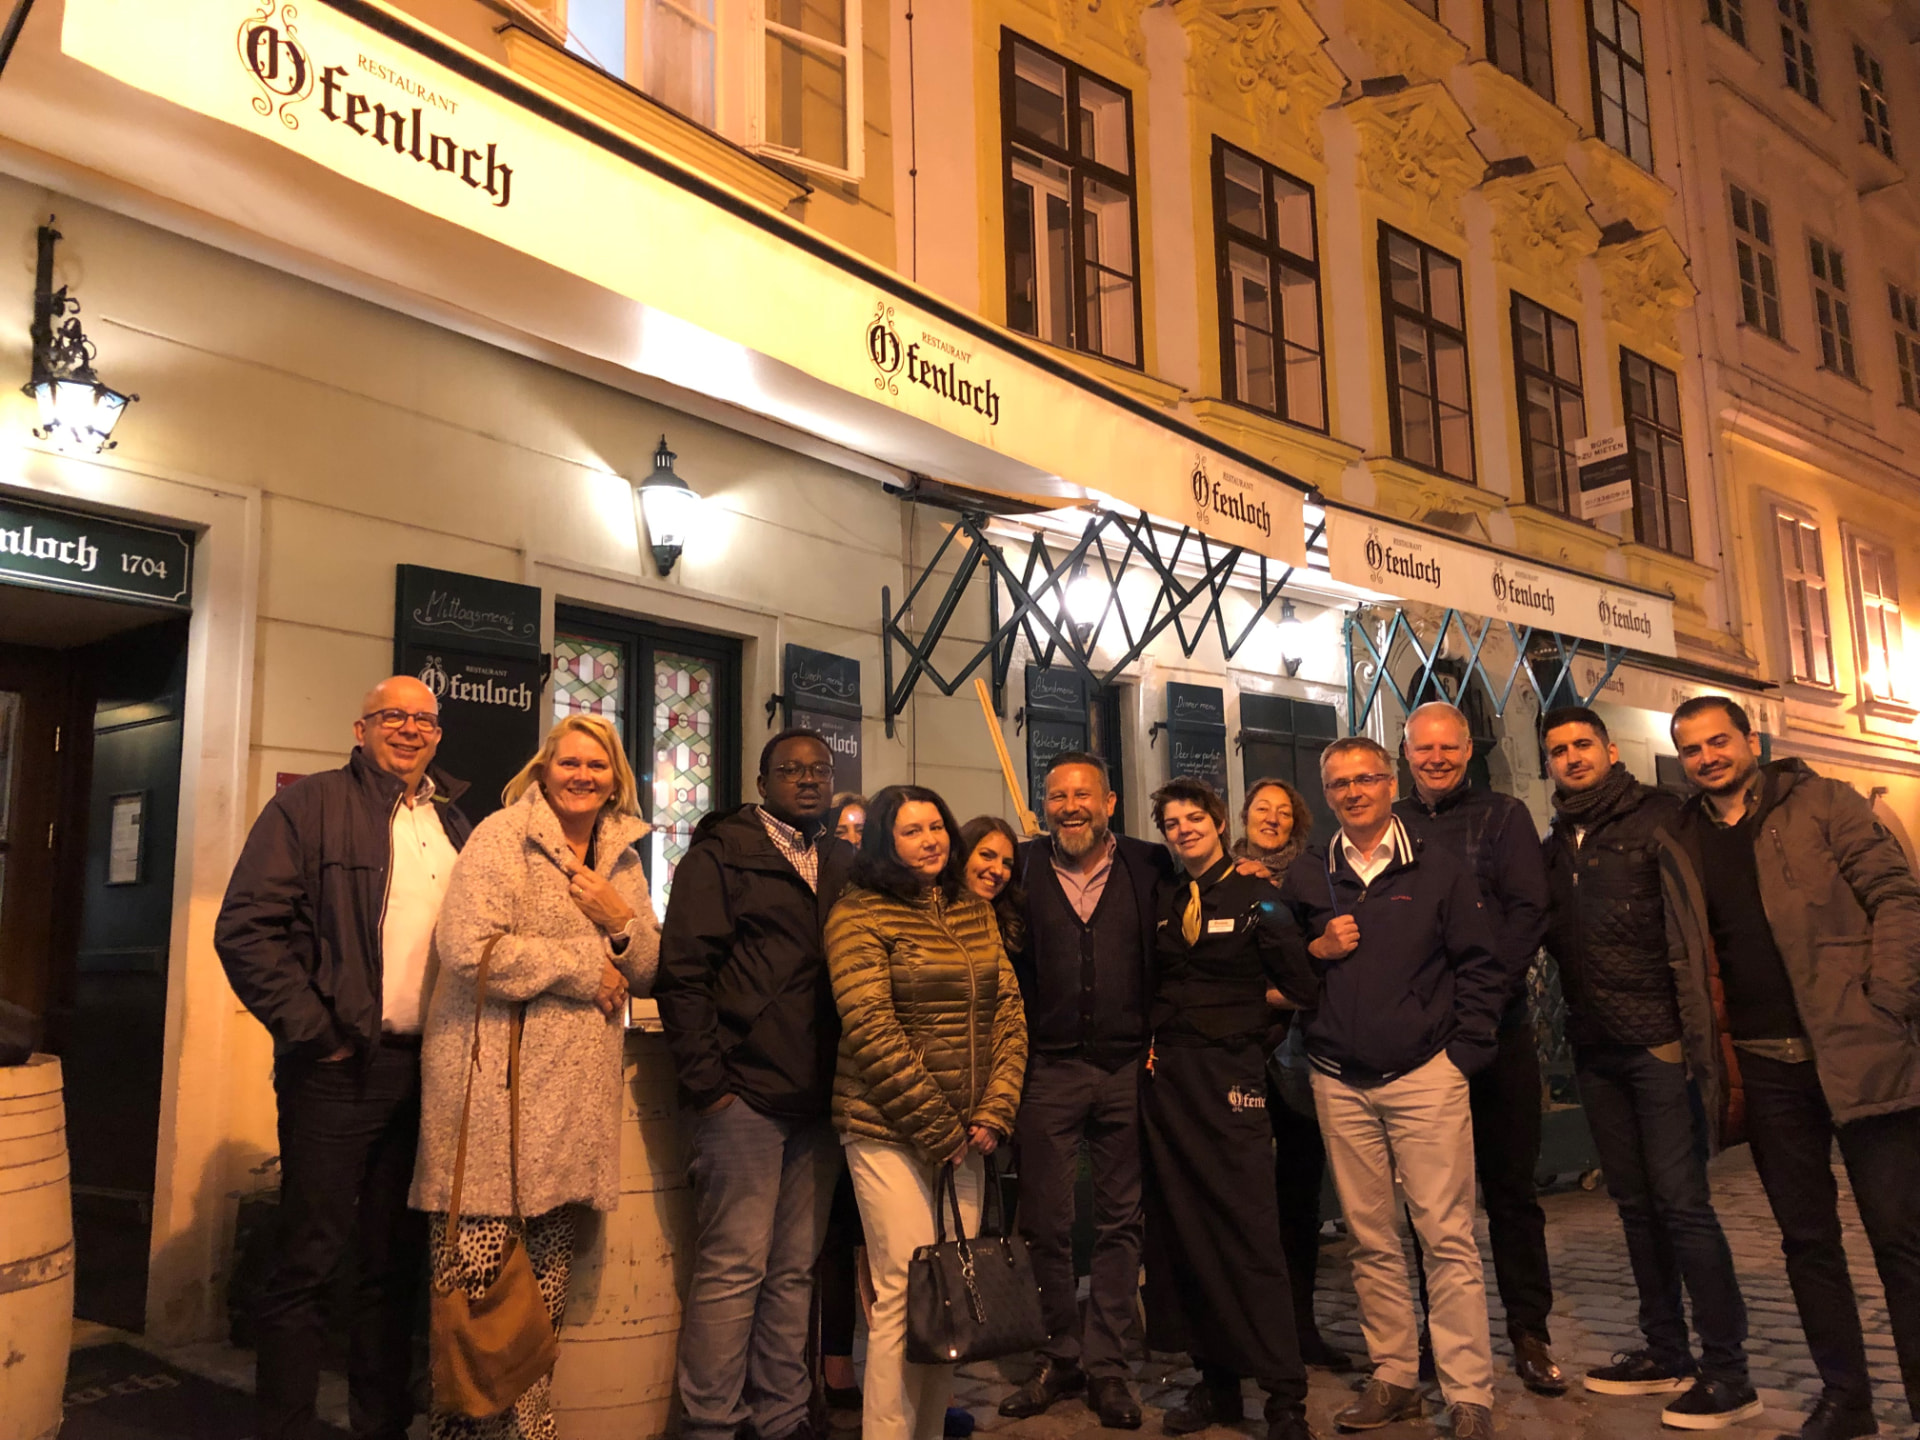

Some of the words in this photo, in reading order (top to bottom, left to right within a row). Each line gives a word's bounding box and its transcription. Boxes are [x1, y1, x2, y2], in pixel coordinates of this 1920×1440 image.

[358, 53, 459, 115] RESTAURANT
[246, 25, 514, 208] Ofenloch
[922, 332, 972, 365] RESTAURANT
[869, 324, 1000, 426] Ofenloch
[1582, 452, 1592, 460] ZU
[1594, 443, 1624, 455] MIETEN
[1192, 471, 1271, 538] Ofenloch
[121, 552, 168, 580] 1704
[1366, 539, 1441, 589] Ofenloch
[1493, 573, 1555, 616] Ofenloch
[1599, 600, 1652, 639] Ofenloch
[421, 668, 533, 712] Ofenloch
